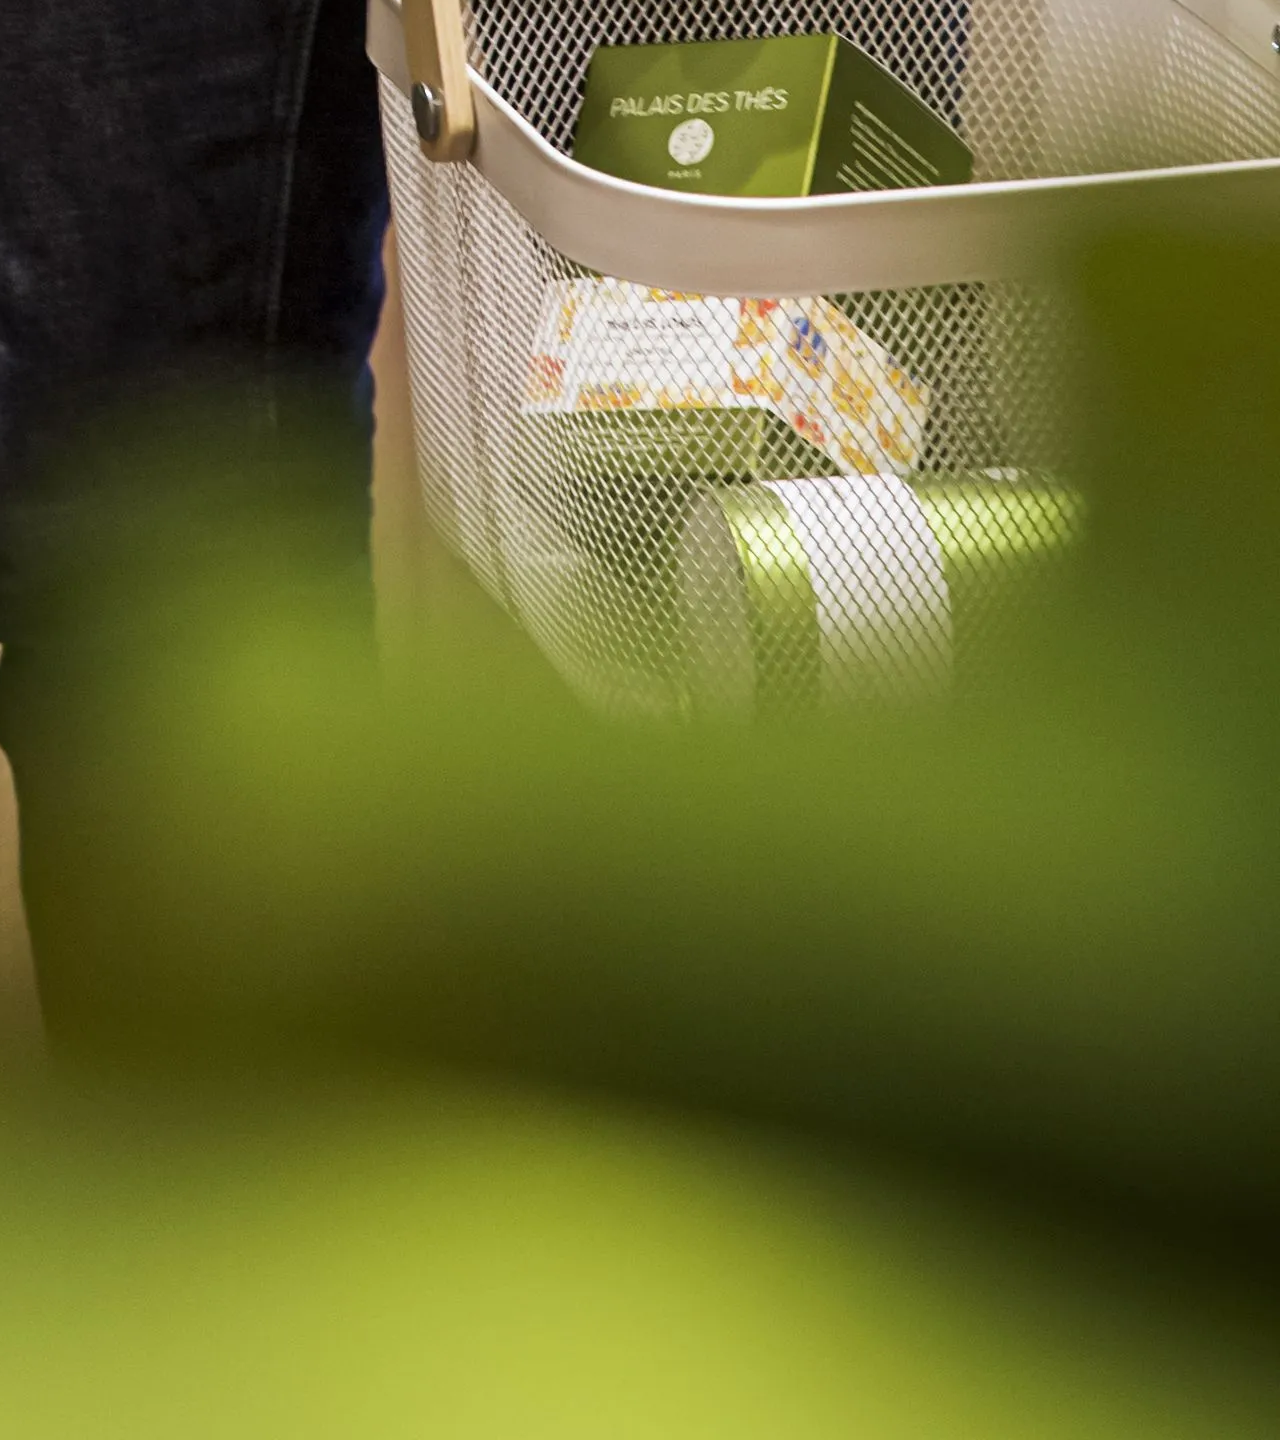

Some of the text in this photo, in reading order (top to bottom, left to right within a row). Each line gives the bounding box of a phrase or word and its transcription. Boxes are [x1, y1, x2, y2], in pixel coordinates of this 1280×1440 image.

[609, 86, 789, 118] PALAIS DES THÉS
